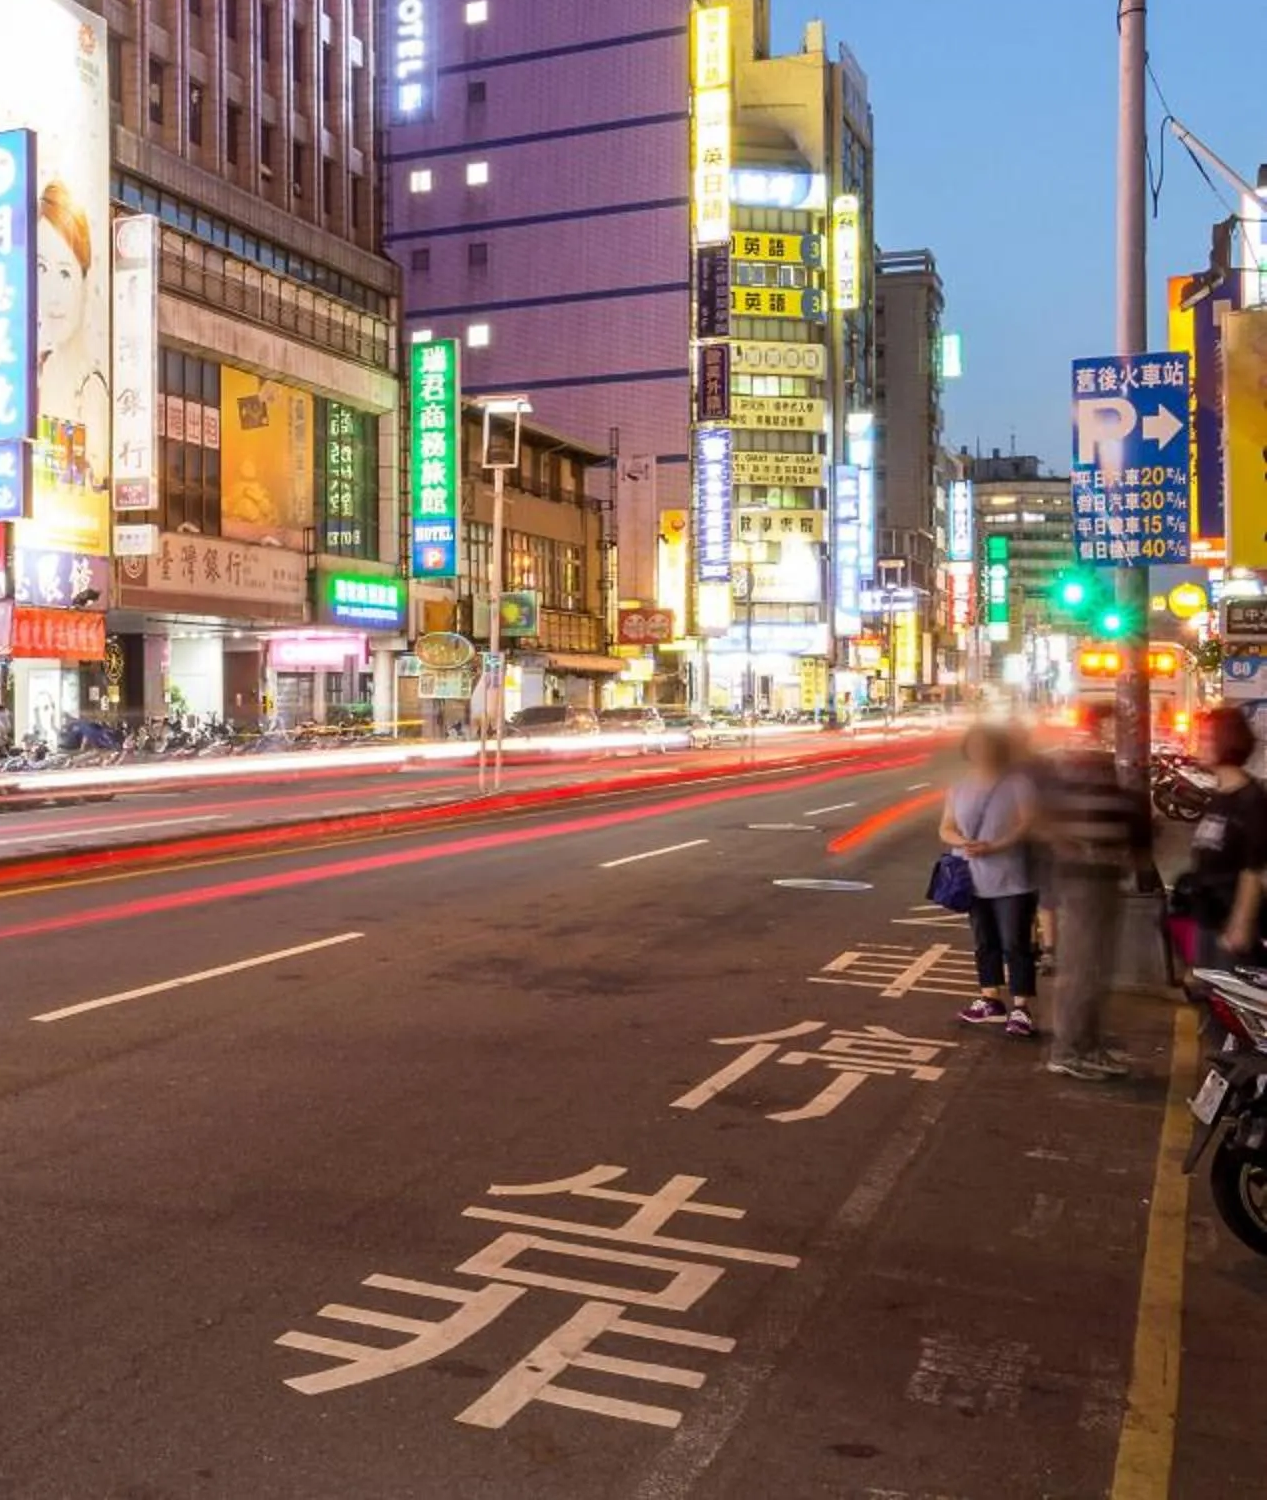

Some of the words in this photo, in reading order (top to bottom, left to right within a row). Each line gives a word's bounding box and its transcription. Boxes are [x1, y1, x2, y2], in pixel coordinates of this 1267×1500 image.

[731, 235, 786, 258] 英語
[731, 292, 786, 313] 英語
[1076, 361, 1185, 394] 舊後火車站
[419, 345, 448, 515] 瑞君商務旅館
[1078, 397, 1138, 465] P
[414, 525, 454, 543] HOTEL
